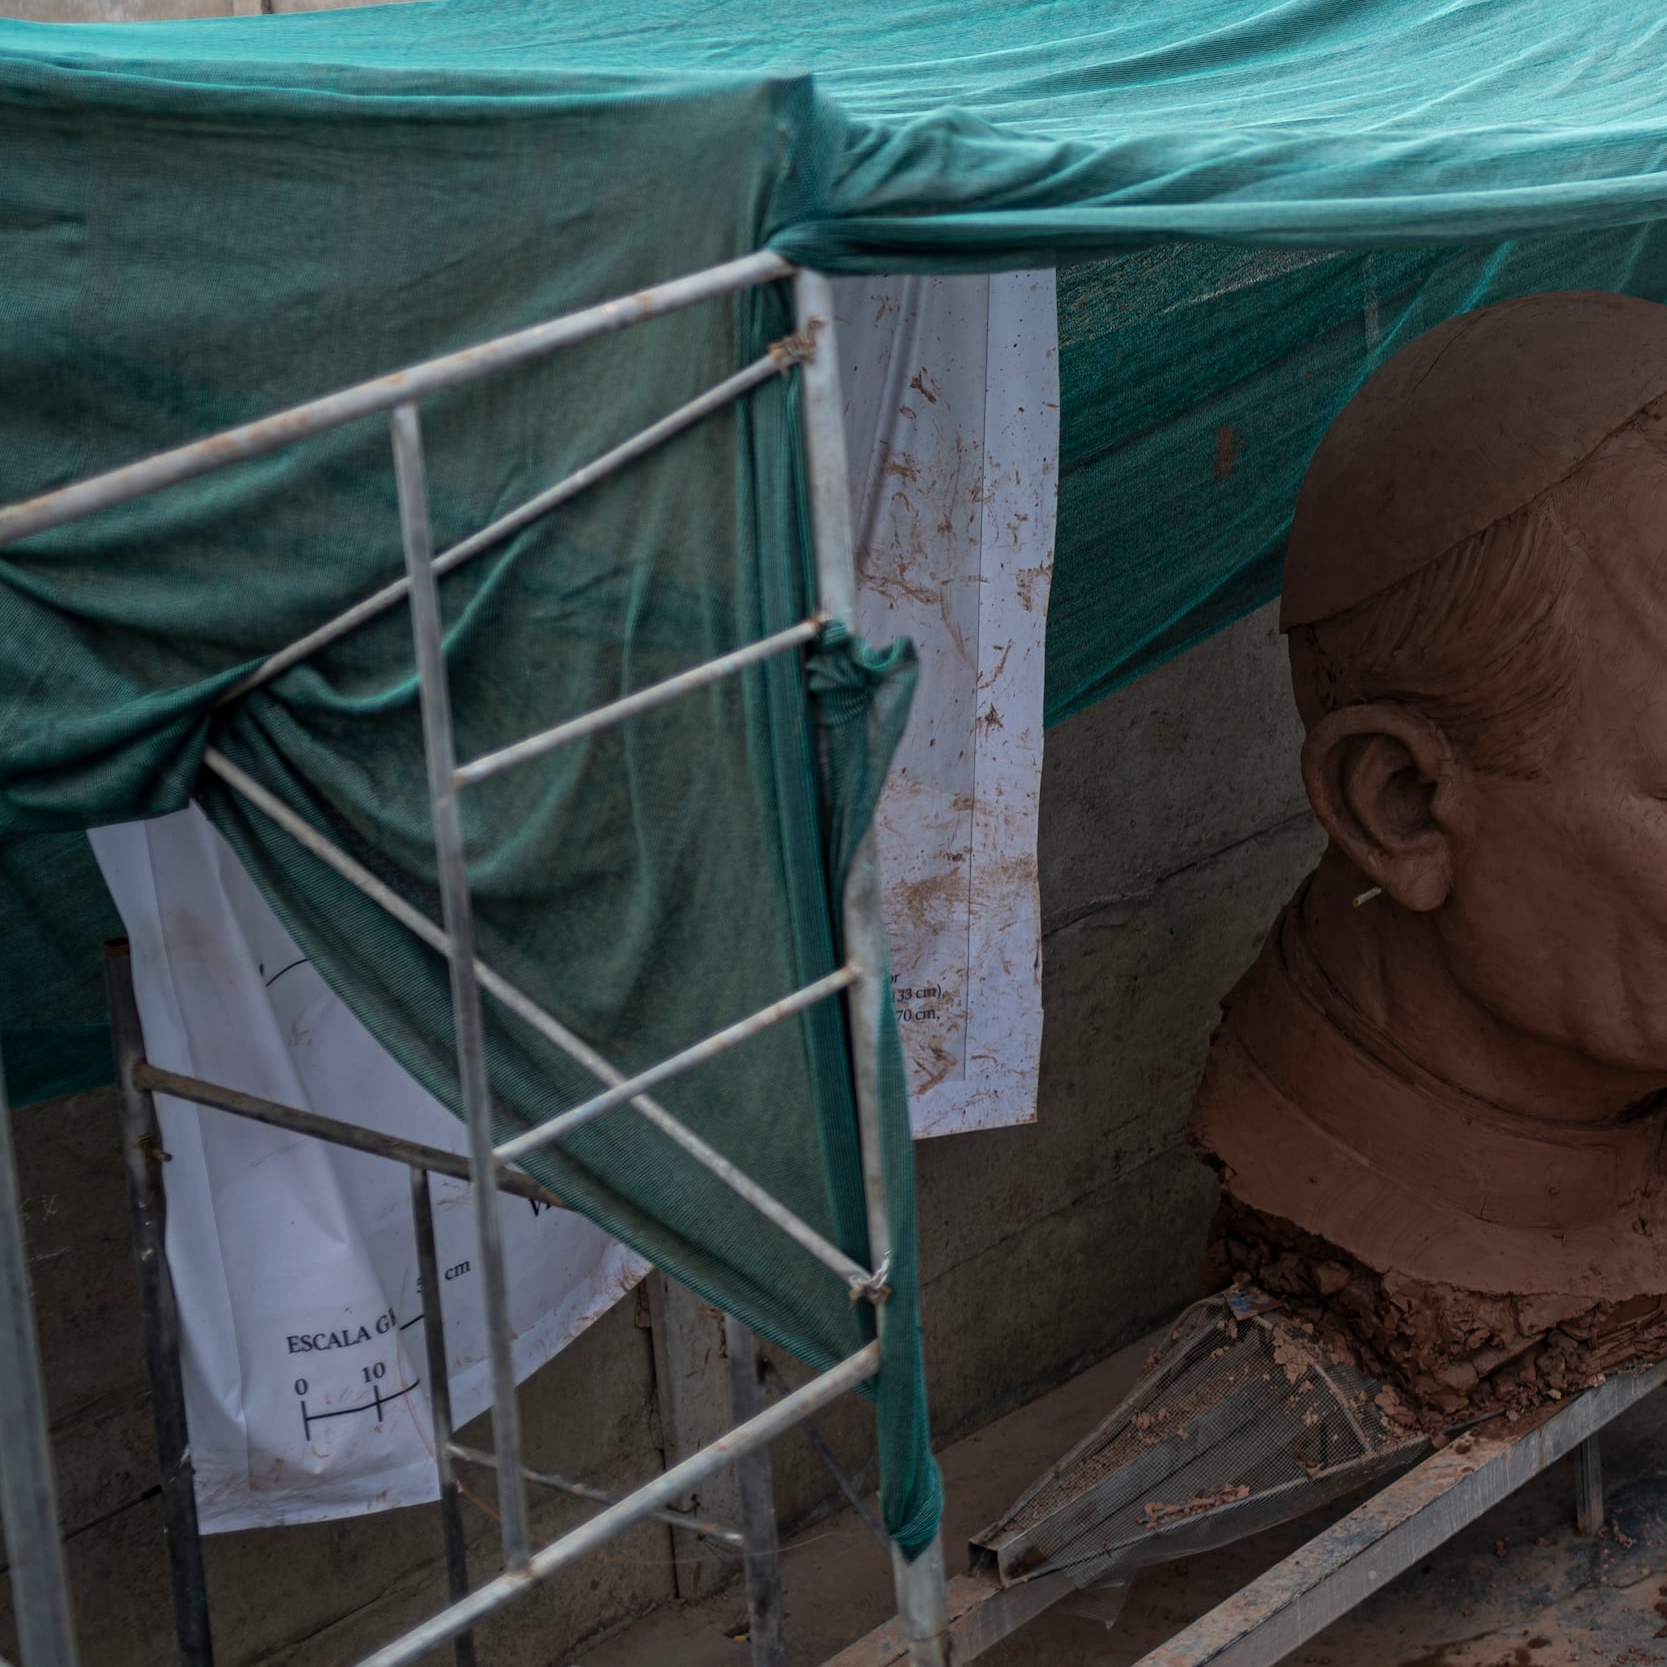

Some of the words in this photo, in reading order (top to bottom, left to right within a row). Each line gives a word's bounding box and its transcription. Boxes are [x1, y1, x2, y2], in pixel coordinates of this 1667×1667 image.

[915, 984, 945, 999] cm),
[915, 1009, 940, 1021] cm,
[444, 1259, 470, 1281] cm
[286, 1325, 372, 1353] ESCALA
[294, 1378, 308, 1395] 0
[361, 1362, 386, 1383] 10
